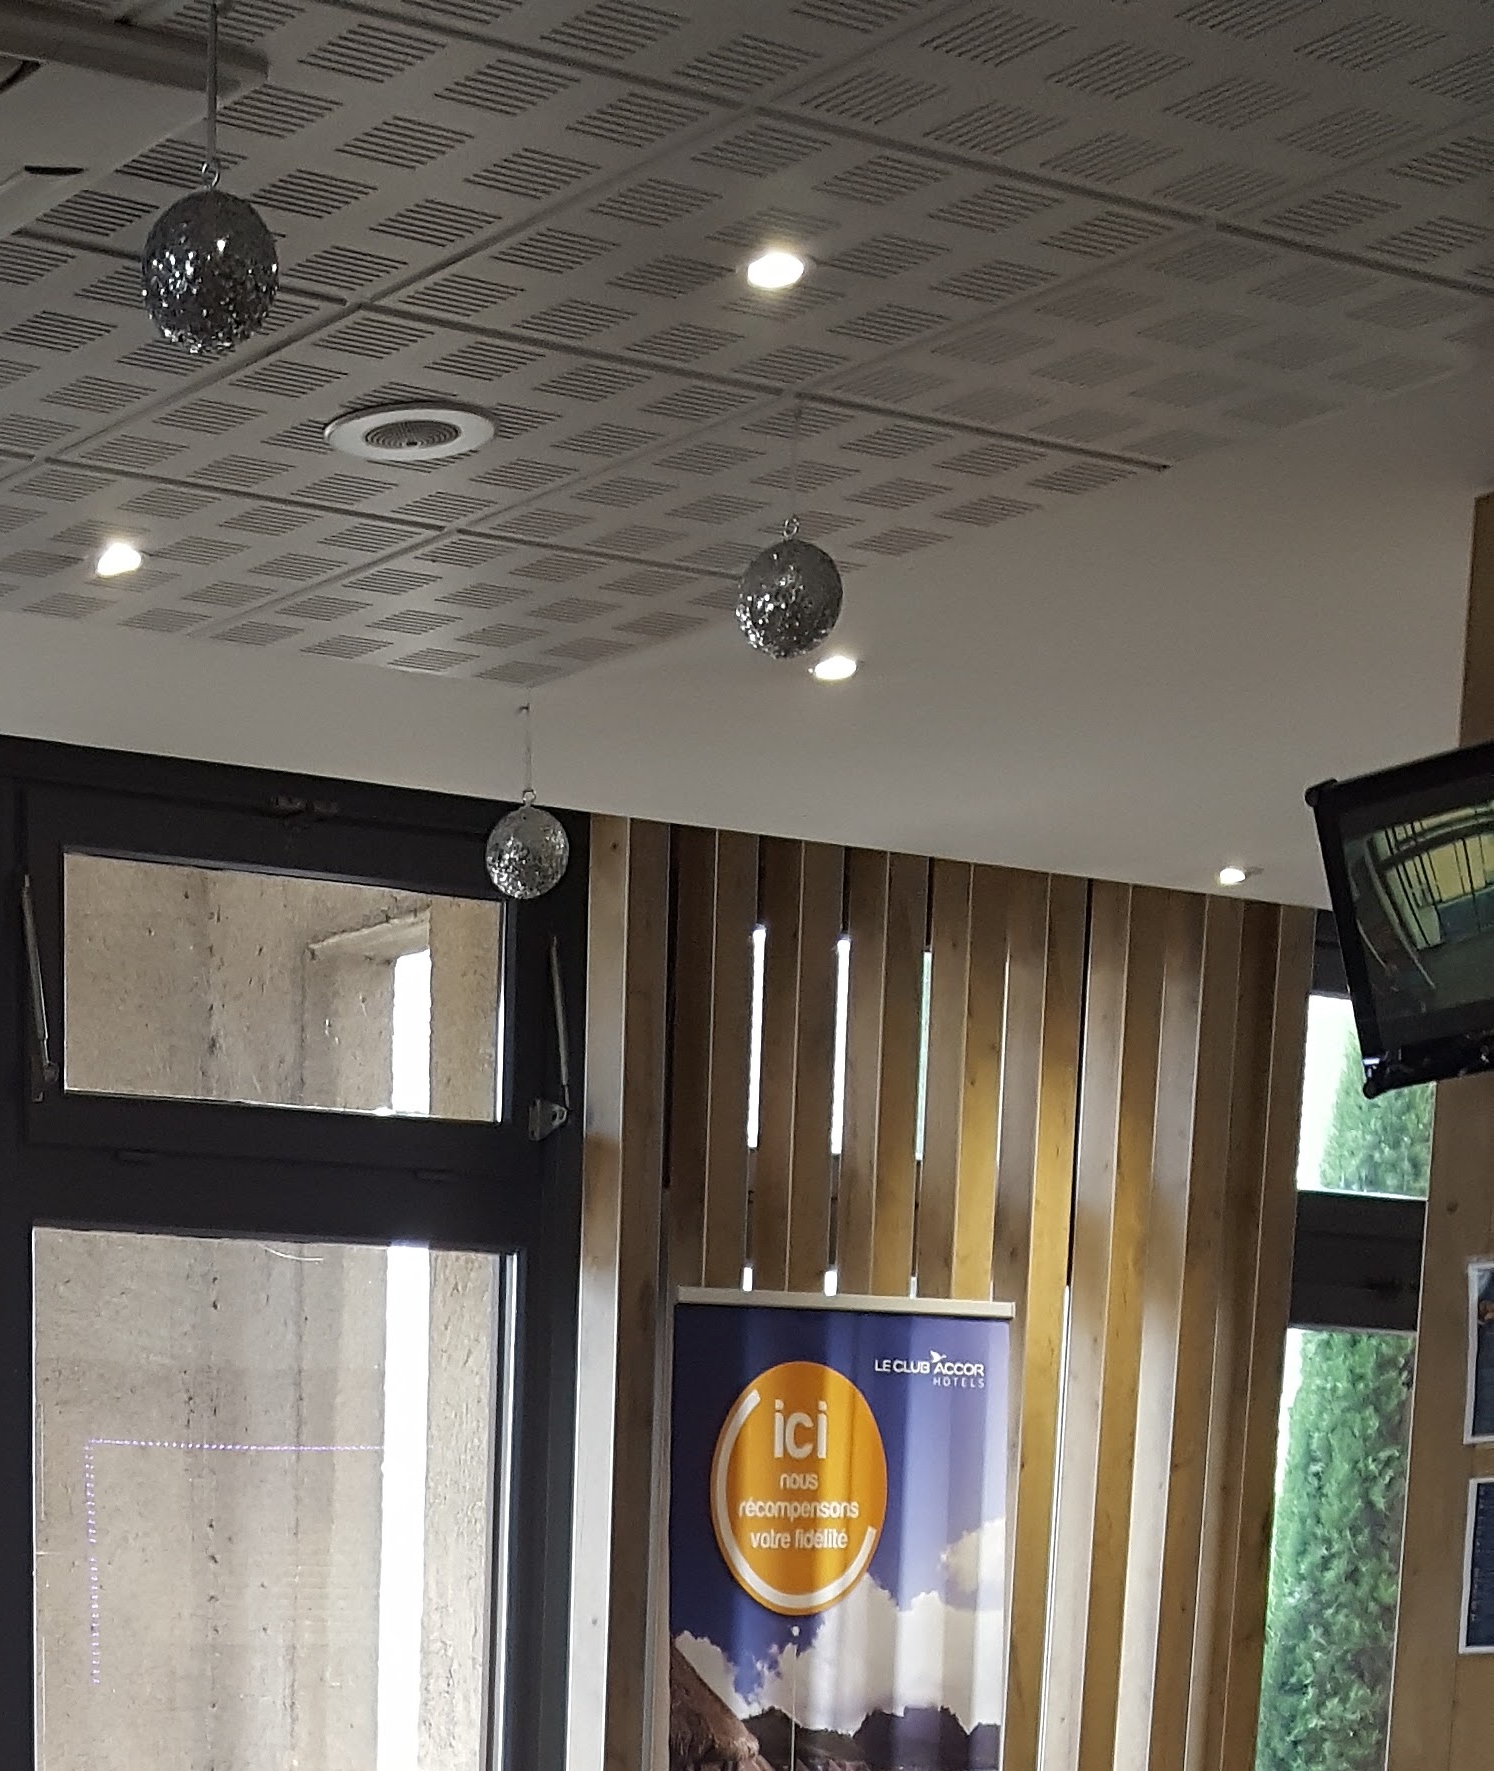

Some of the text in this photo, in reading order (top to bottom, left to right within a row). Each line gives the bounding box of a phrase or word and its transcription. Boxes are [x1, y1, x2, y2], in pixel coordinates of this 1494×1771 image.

[874, 1359, 985, 1377] LE CLUB ACCOR
[932, 1377, 985, 1389] HOTELS
[773, 1398, 828, 1460] ici
[779, 1471, 819, 1491] nous
[738, 1496, 859, 1524] récompensons
[750, 1526, 848, 1550] votre fidélité
